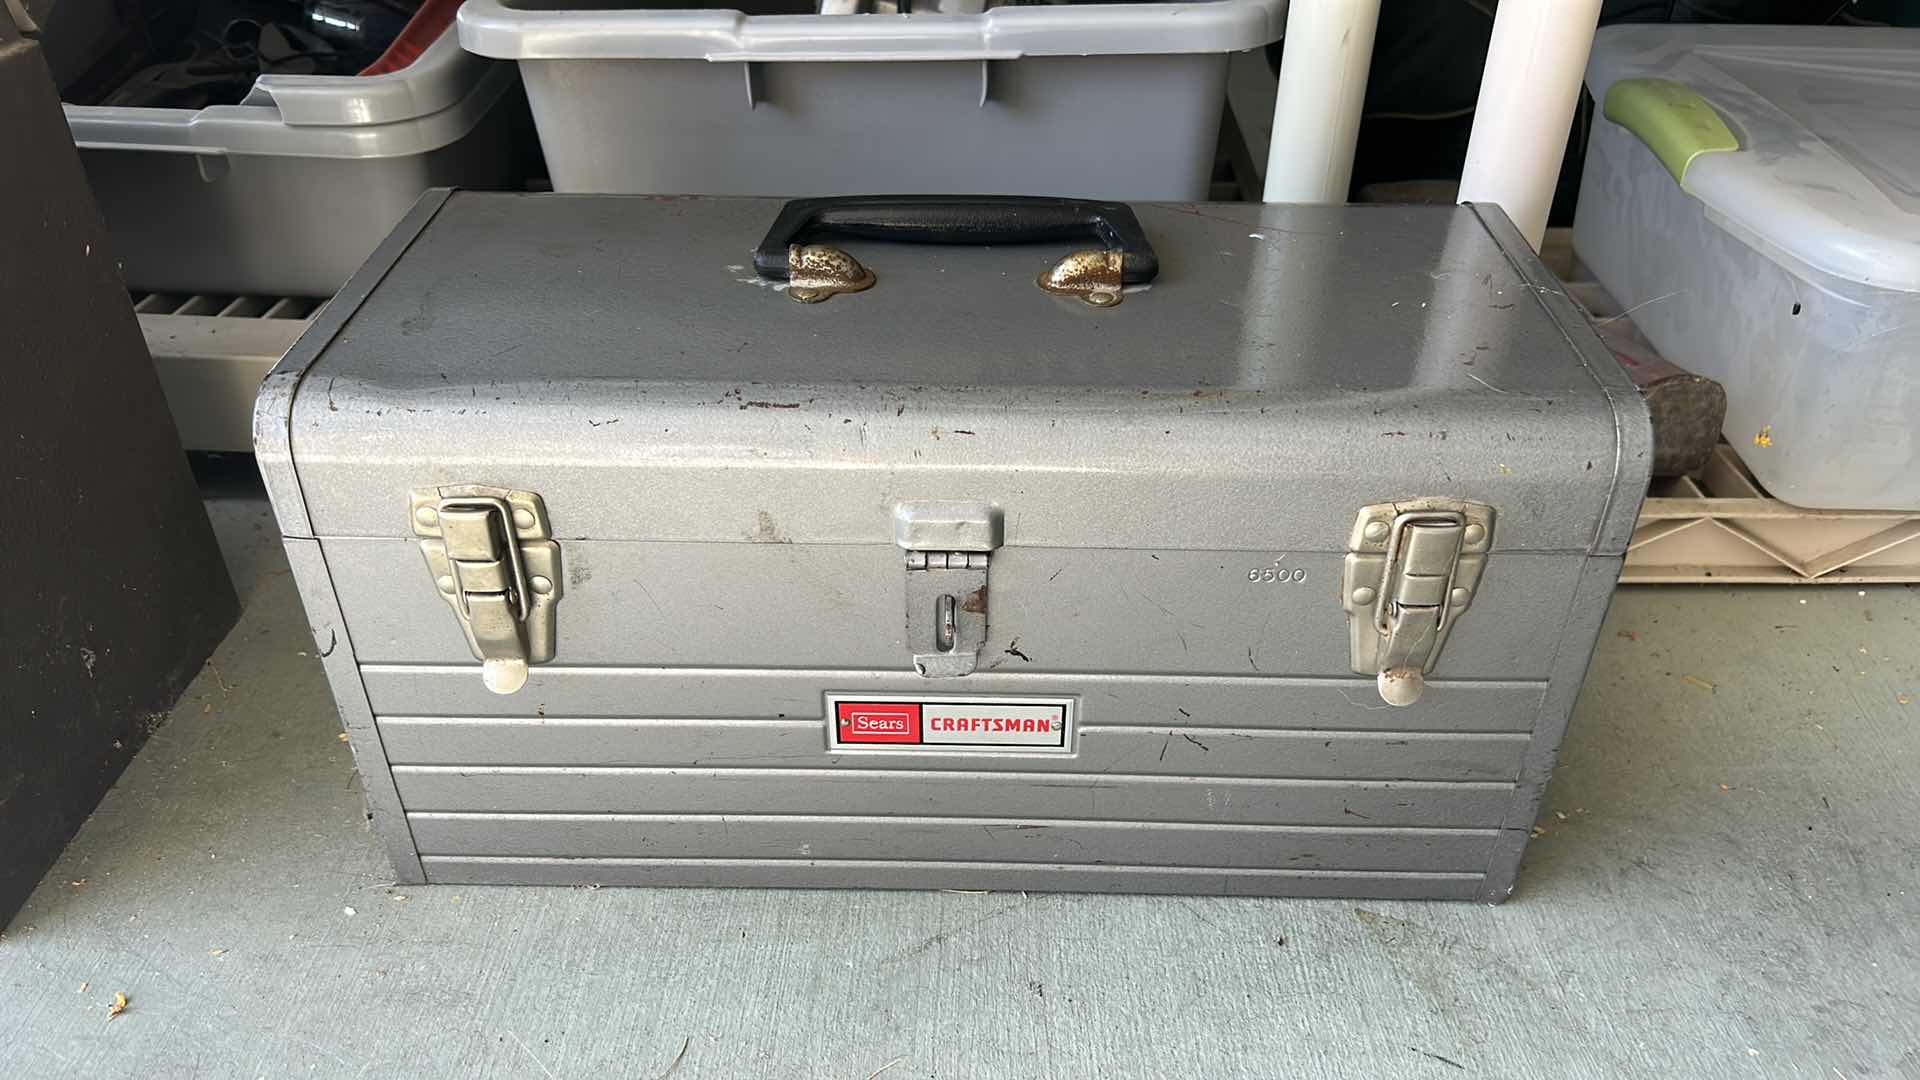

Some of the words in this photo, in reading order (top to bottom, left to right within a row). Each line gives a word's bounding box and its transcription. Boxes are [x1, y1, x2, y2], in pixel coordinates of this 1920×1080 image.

[1248, 567, 1307, 583] 6500
[857, 716, 905, 730] Sears
[930, 717, 1050, 733] CRAFTSMAN
